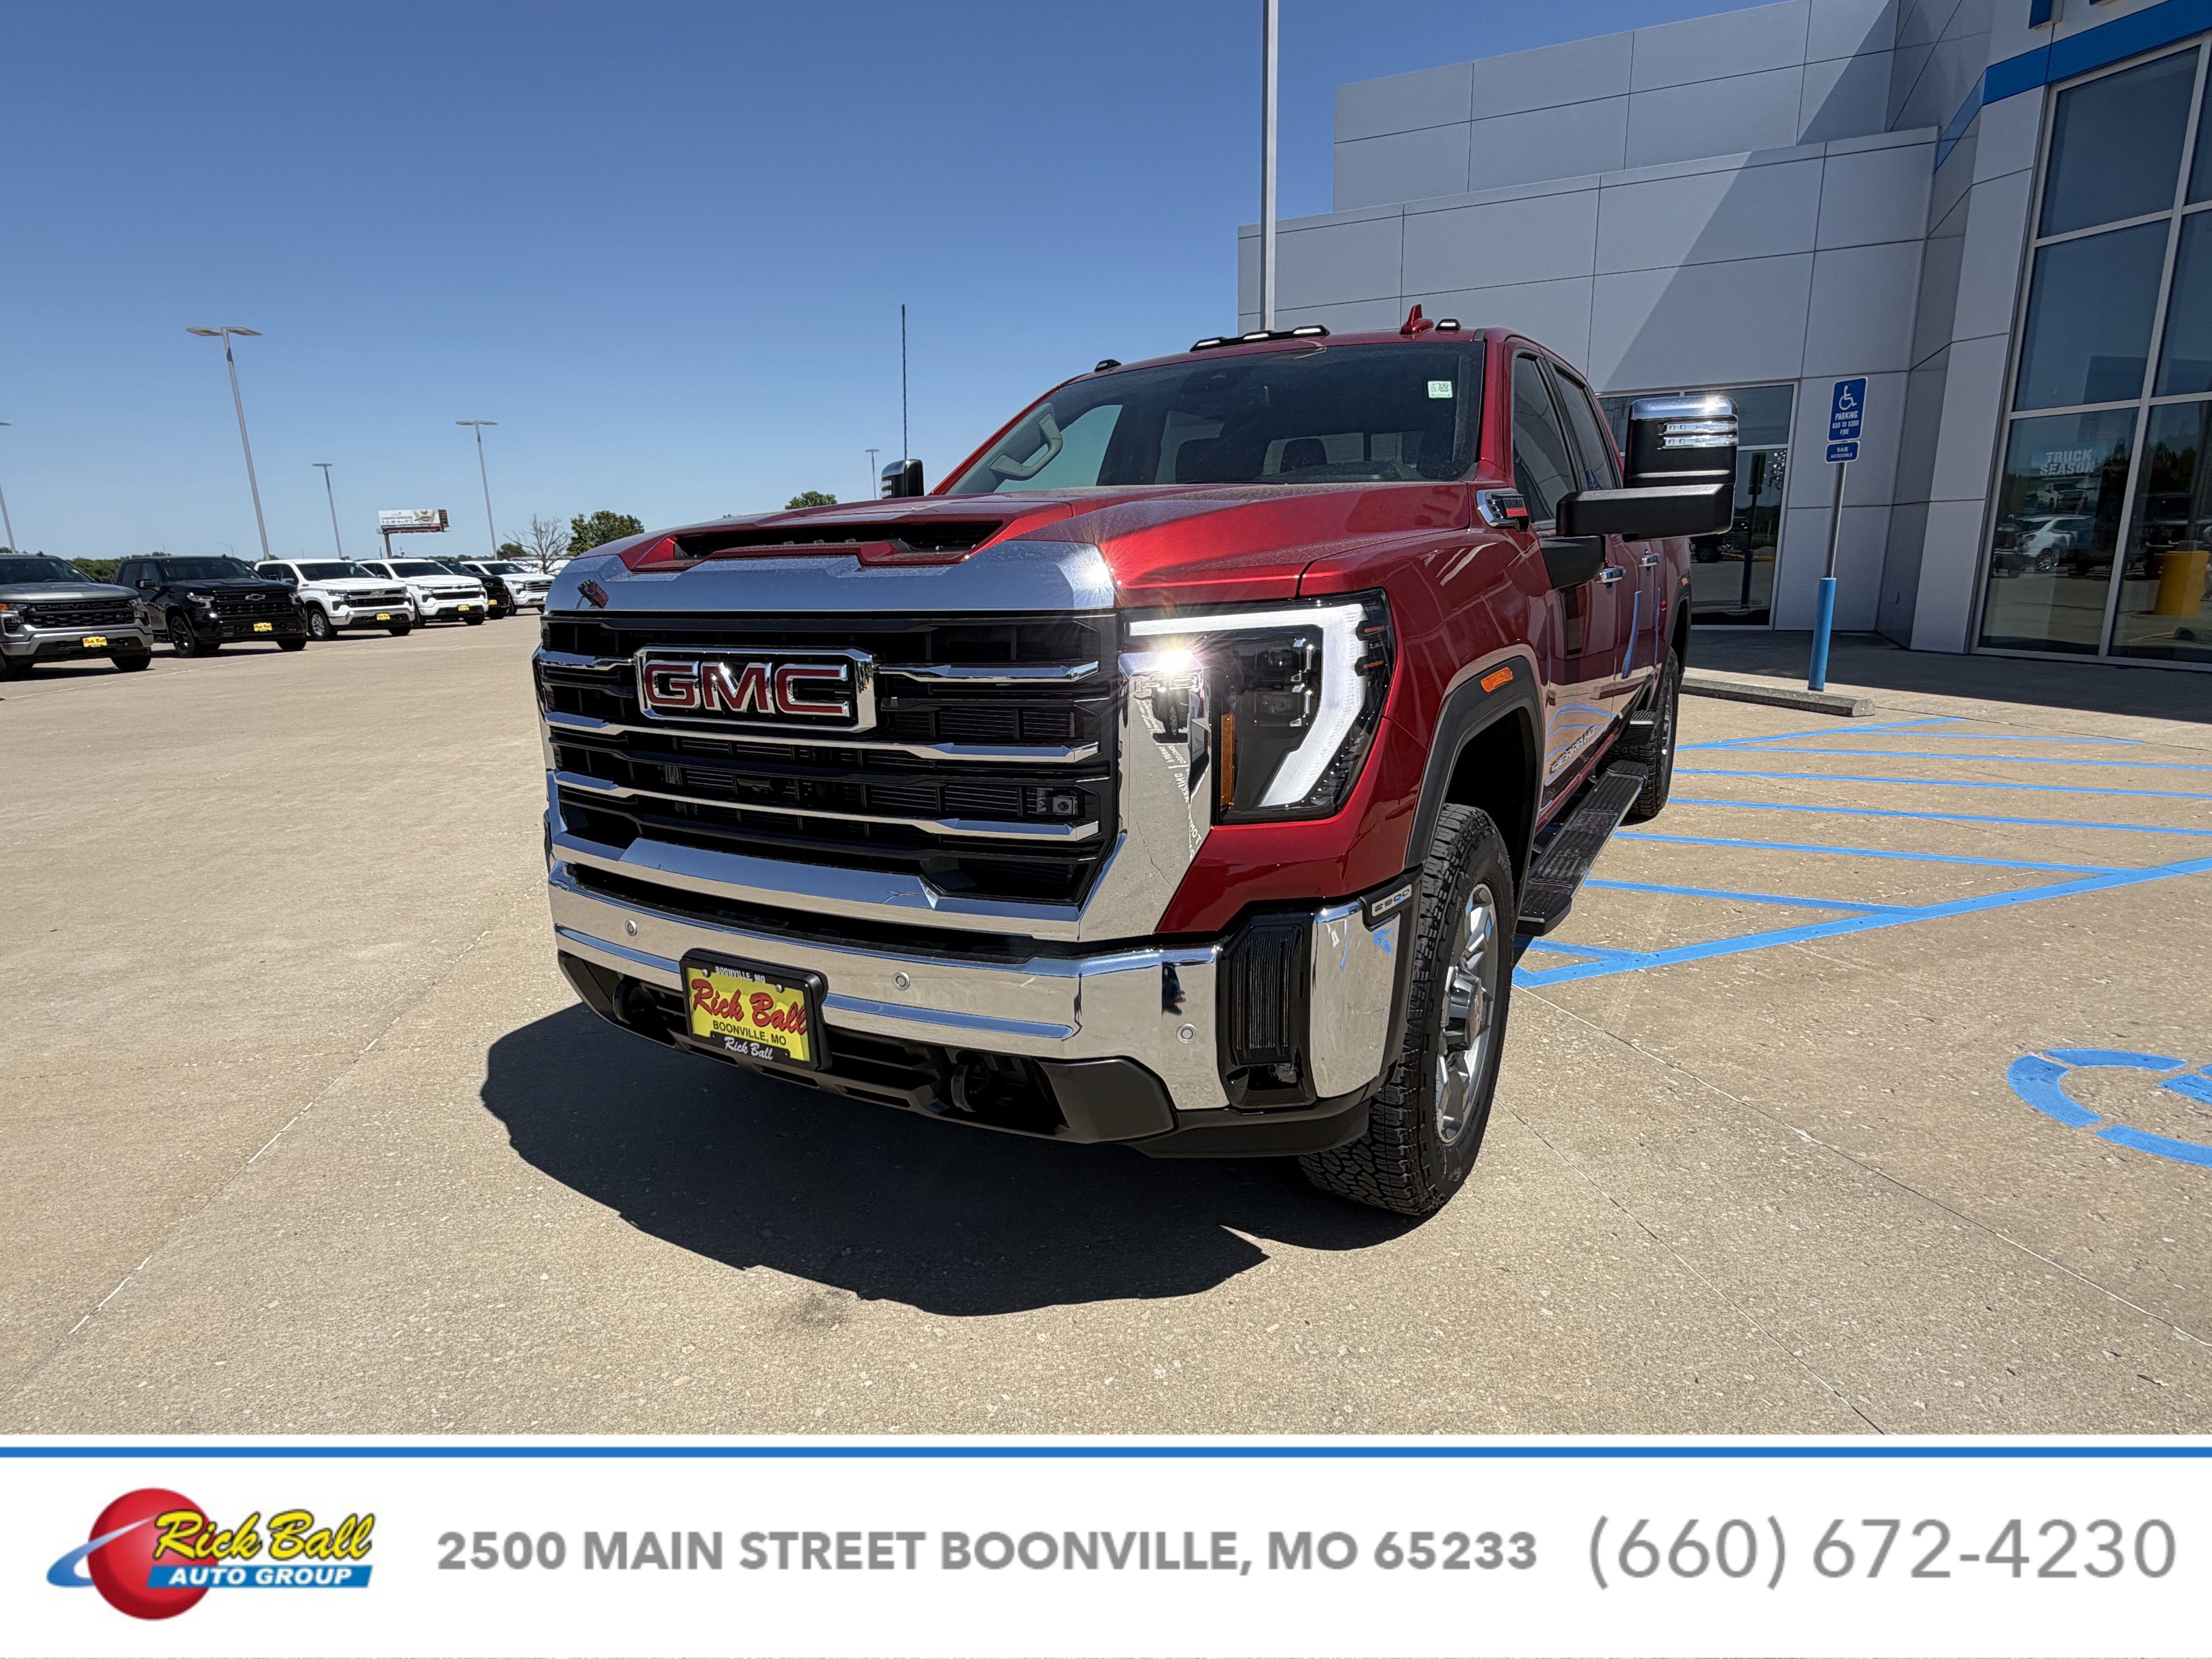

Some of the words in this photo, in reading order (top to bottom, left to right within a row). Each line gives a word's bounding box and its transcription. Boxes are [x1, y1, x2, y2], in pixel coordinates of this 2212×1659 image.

[1836, 411, 1858, 420] PARKING
[2045, 449, 2093, 463] TRUCK
[2039, 461, 2095, 476] SEASON
[644, 659, 852, 717] GMC
[715, 966, 753, 982] BOONVILLE,
[754, 974, 766, 983] MO
[691, 978, 745, 1022] Rick
[749, 992, 807, 1035] Ball
[713, 1020, 768, 1044] BOONVILLE,
[771, 1033, 787, 1046] MO
[724, 1036, 749, 1054] Rick
[750, 1043, 773, 1060] Ball
